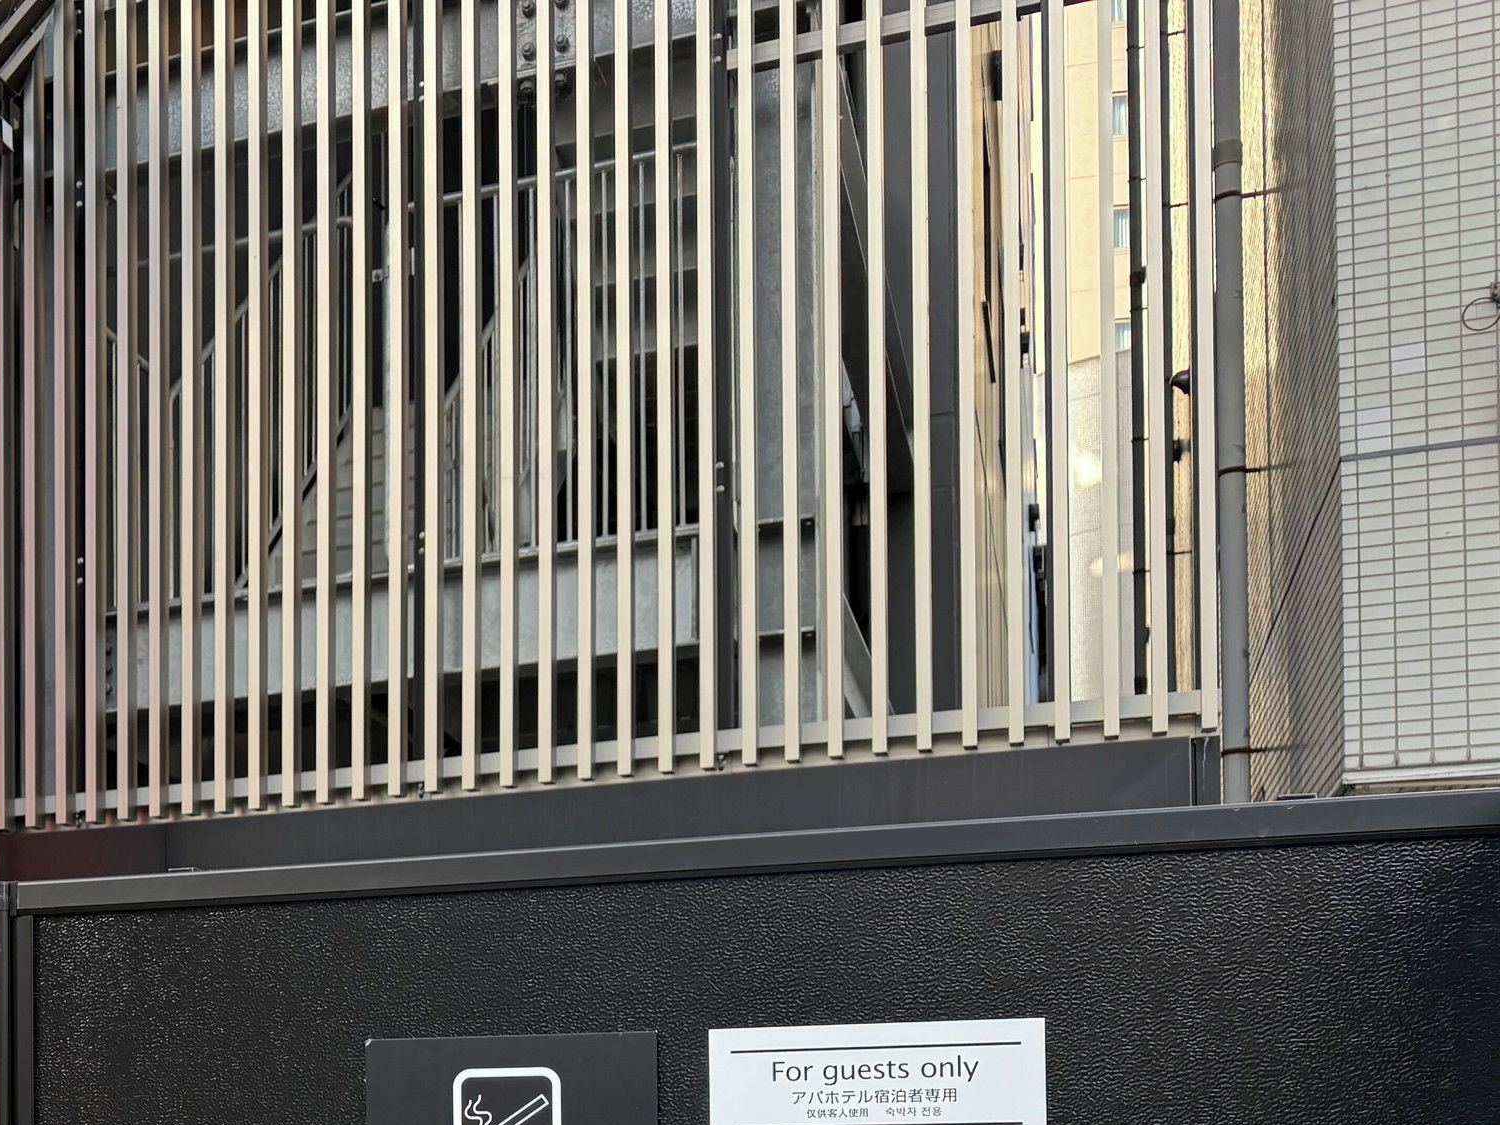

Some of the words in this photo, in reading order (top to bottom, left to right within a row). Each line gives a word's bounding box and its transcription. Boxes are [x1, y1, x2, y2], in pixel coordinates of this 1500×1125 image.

[771, 1061, 814, 1082] For
[822, 1059, 910, 1086] guests
[920, 1055, 980, 1082] only
[792, 1087, 958, 1105] アパホテル宿泊者専用
[885, 1106, 917, 1118] 숙박자
[921, 1105, 943, 1117] 전용
